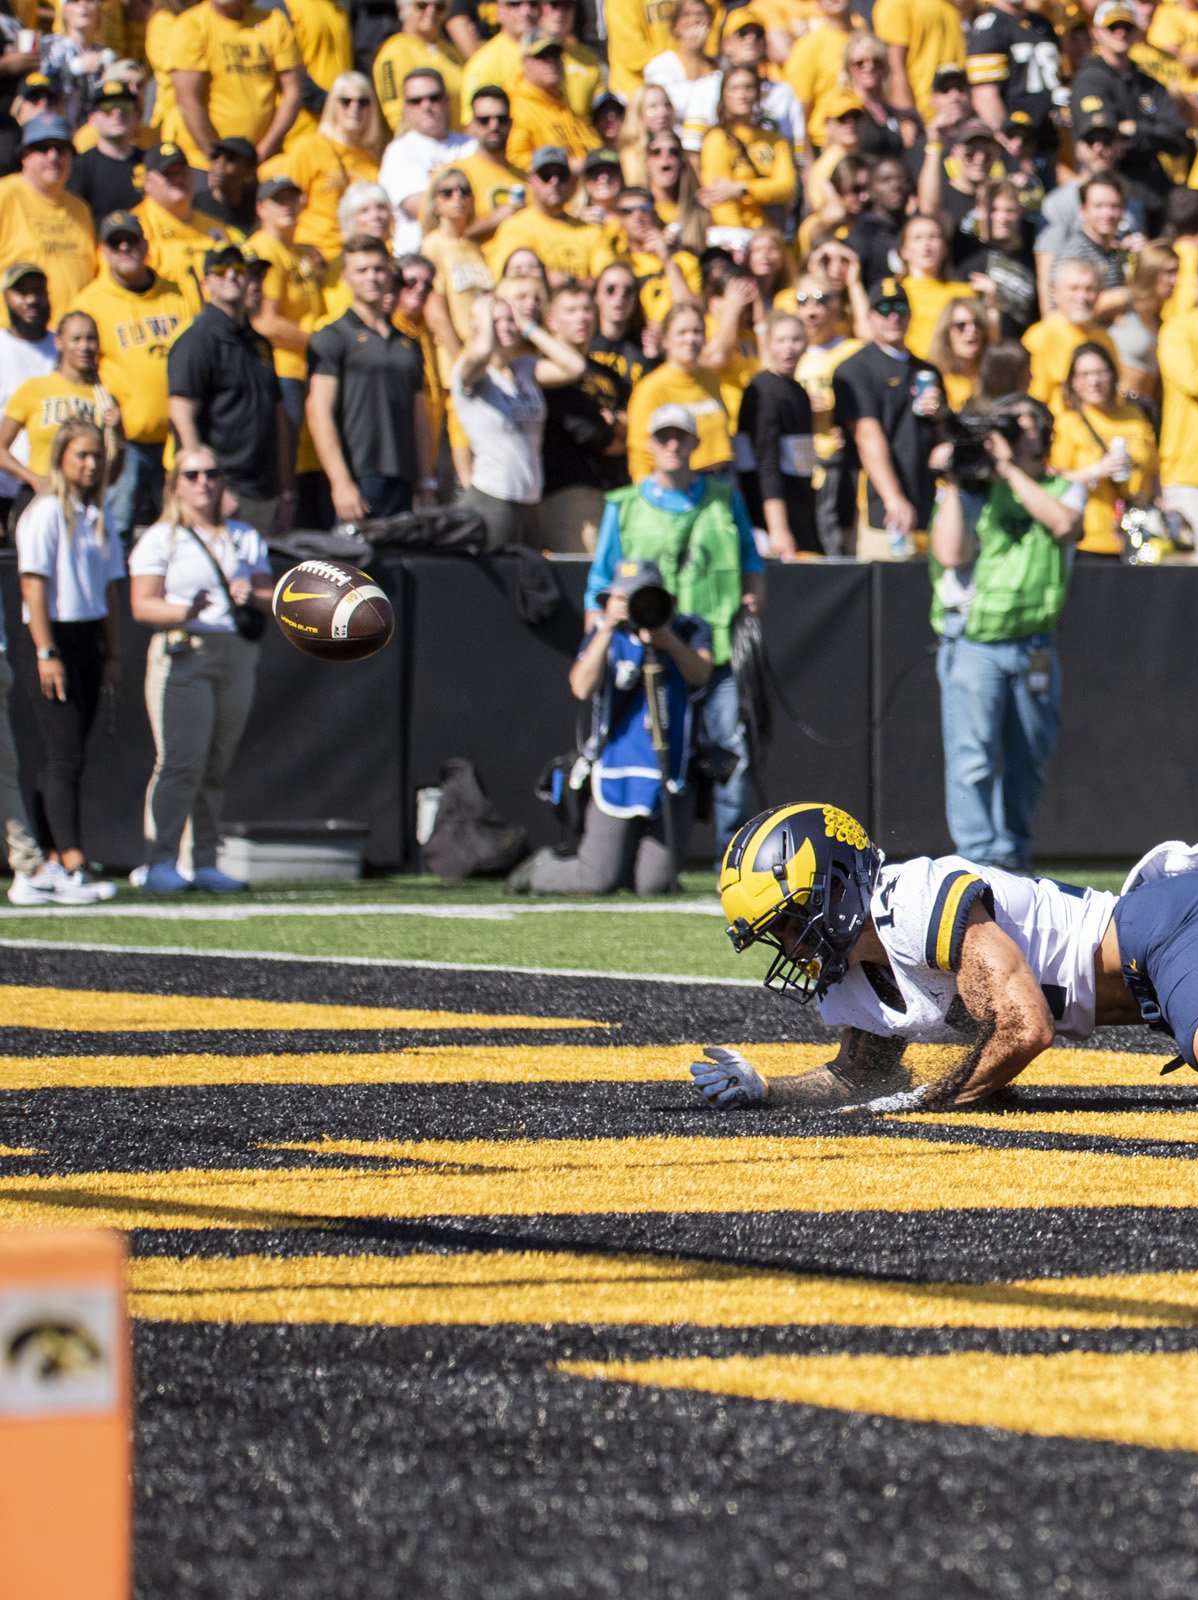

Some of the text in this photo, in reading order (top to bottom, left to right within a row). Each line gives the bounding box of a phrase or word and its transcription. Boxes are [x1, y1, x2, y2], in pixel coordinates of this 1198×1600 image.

[41, 397, 96, 428] IOW
[297, 623, 319, 634] ELITE
[874, 874, 902, 932] 14
